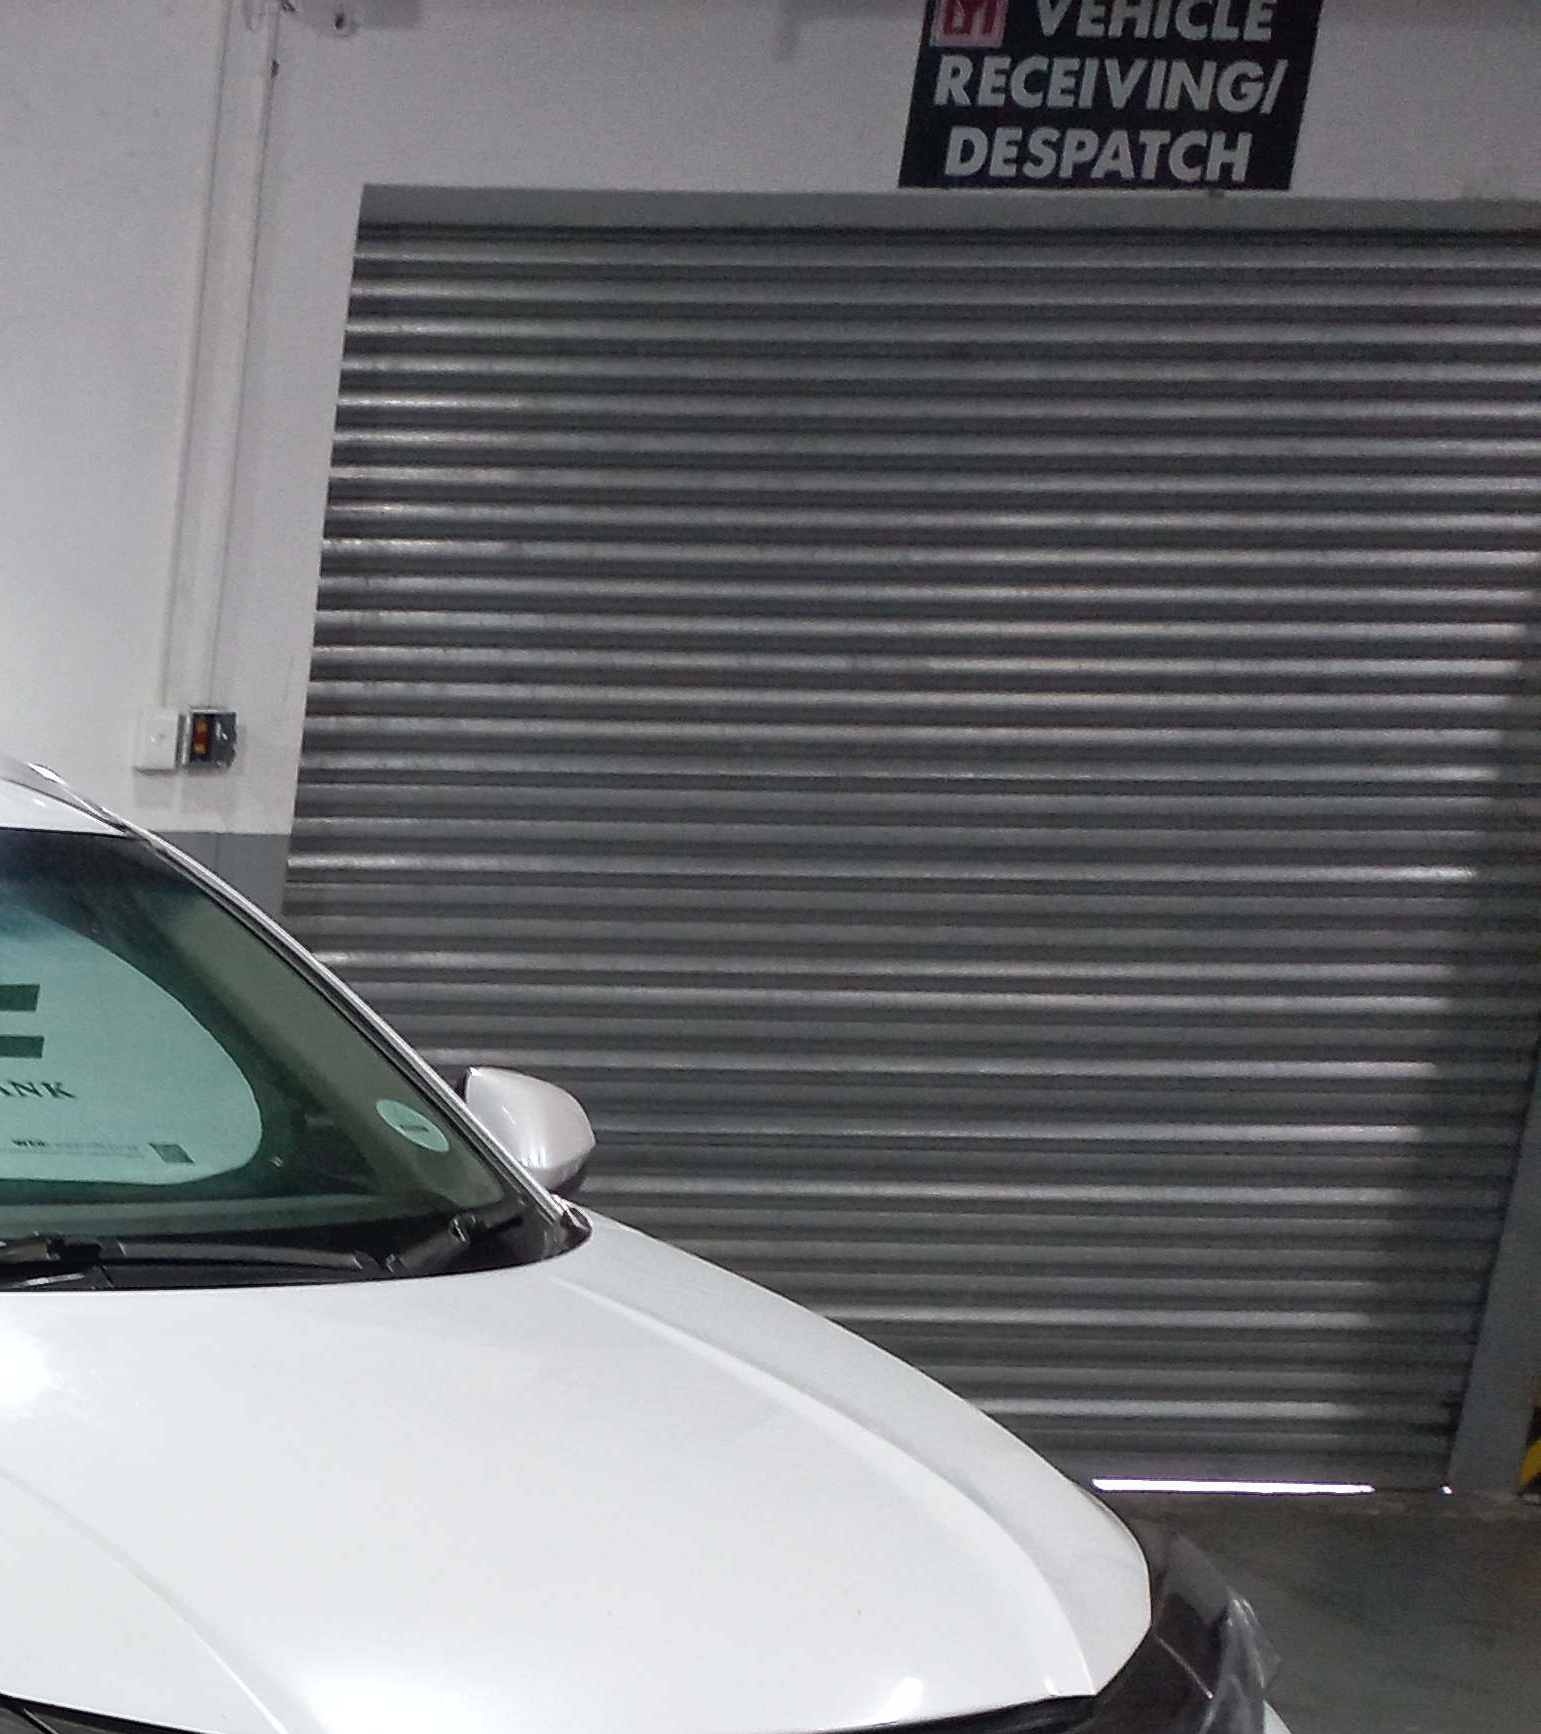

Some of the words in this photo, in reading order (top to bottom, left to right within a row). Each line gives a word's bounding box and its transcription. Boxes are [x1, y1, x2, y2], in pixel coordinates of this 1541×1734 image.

[1037, 0, 1278, 42] VEHICLE
[934, 55, 1288, 114] RECEIVING/
[943, 125, 1254, 183] DESPATCH
